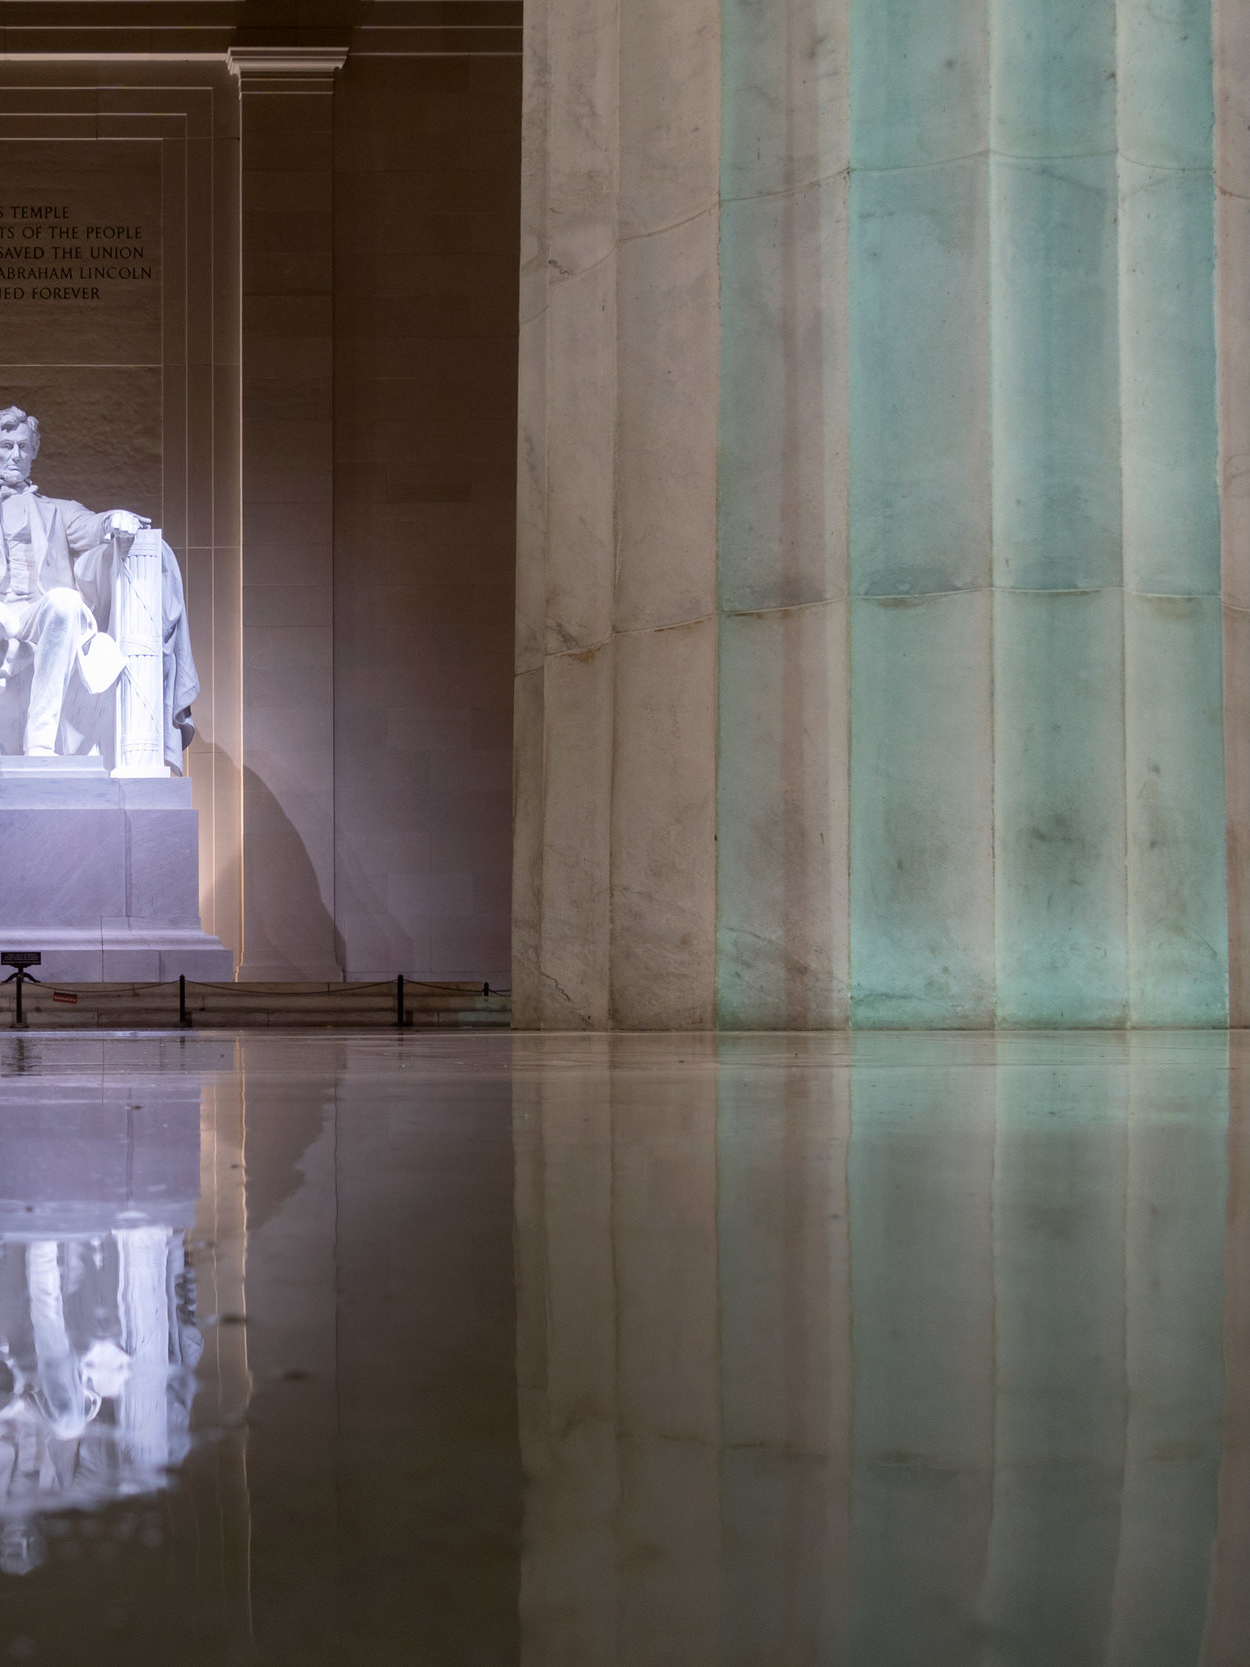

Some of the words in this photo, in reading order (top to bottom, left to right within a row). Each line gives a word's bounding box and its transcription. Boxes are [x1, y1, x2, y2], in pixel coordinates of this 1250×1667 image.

[10, 206, 69, 219] TEMPLE
[22, 226, 42, 239] OF
[48, 226, 78, 239] THE
[87, 226, 141, 239] PEOPLE
[51, 247, 82, 259] THE
[91, 247, 143, 259] UNION
[80, 267, 151, 279] LINCOLN
[32, 287, 101, 299] FOREVER
